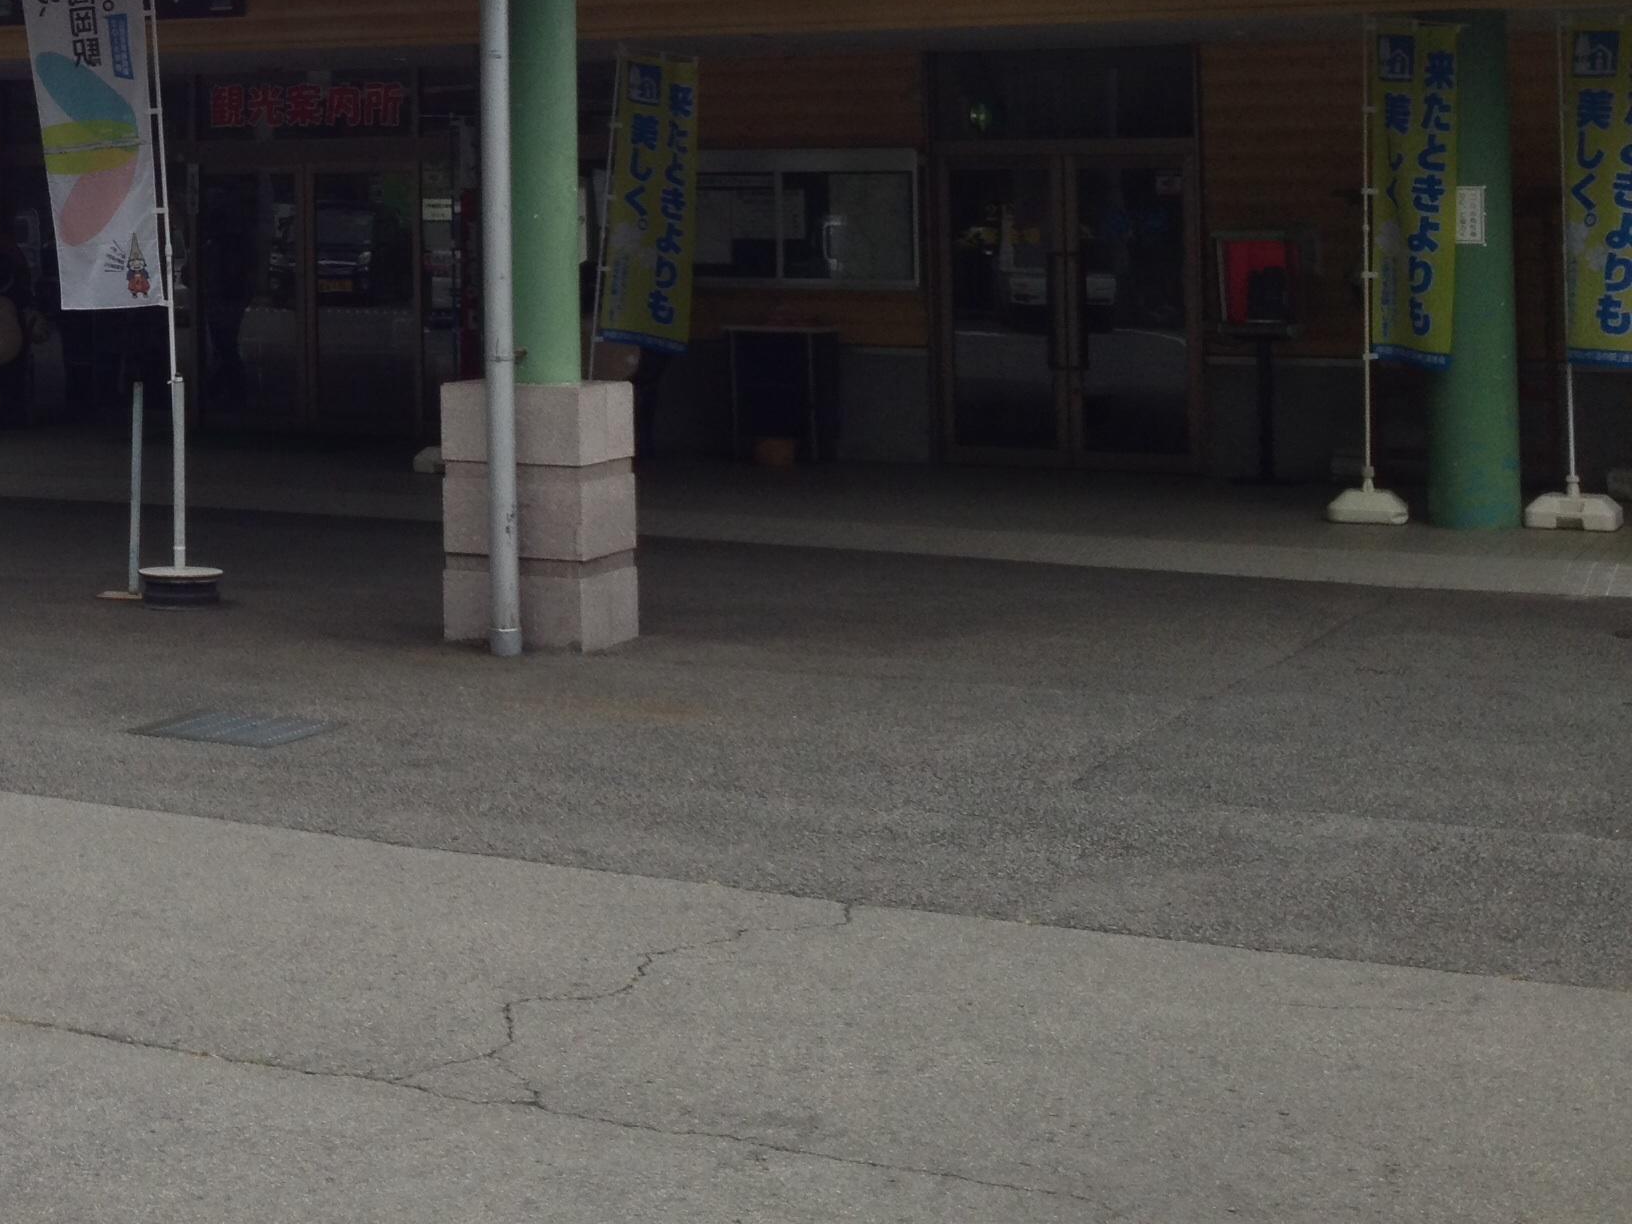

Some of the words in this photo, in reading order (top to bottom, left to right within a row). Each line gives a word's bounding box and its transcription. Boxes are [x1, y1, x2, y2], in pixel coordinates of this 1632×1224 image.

[209, 81, 402, 129] 観光案内所
